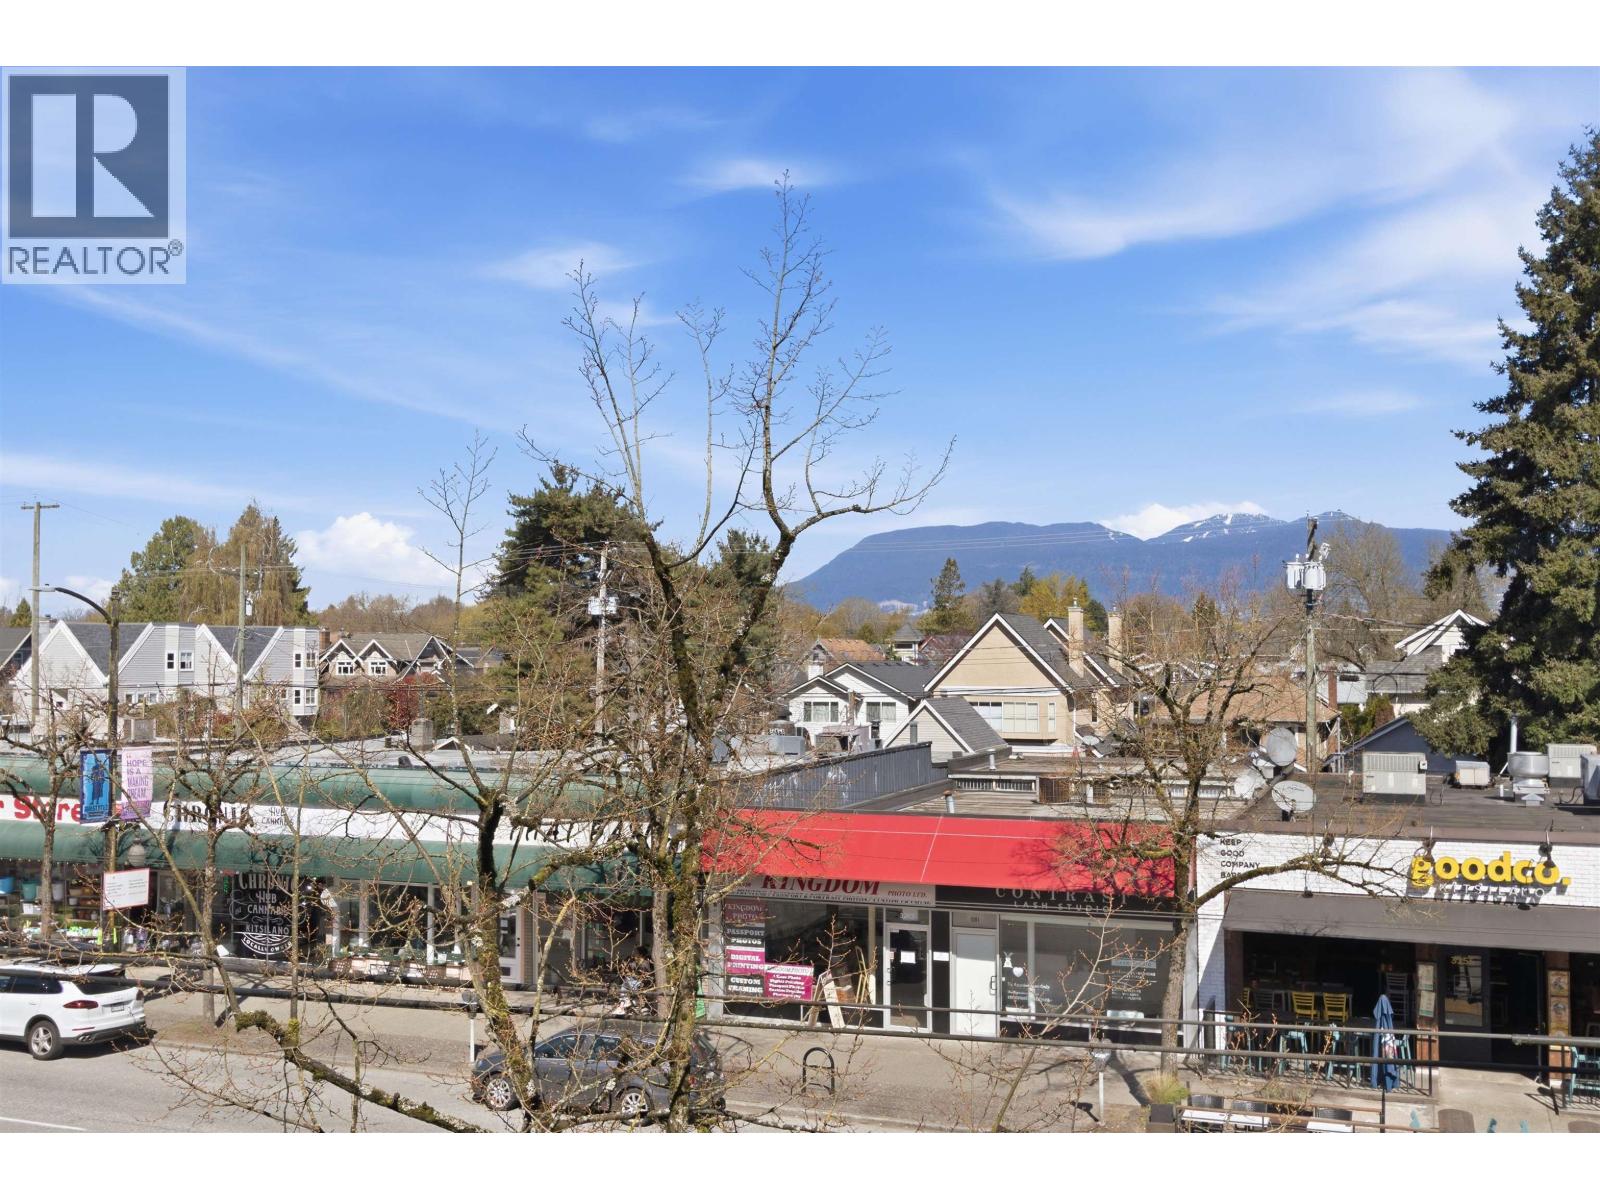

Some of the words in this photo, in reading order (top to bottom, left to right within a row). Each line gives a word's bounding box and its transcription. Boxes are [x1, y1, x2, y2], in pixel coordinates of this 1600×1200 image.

[1220, 849, 1245, 857] GOOD
[1220, 861, 1260, 869] COMPANY
[761, 875, 880, 895] KINGDOM
[1014, 901, 1048, 909] LASH
[246, 924, 289, 935] KITSILANO
[726, 928, 765, 936] PASSPORT
[730, 954, 761, 962] DIGITAL
[731, 977, 761, 985] CUSTOM
